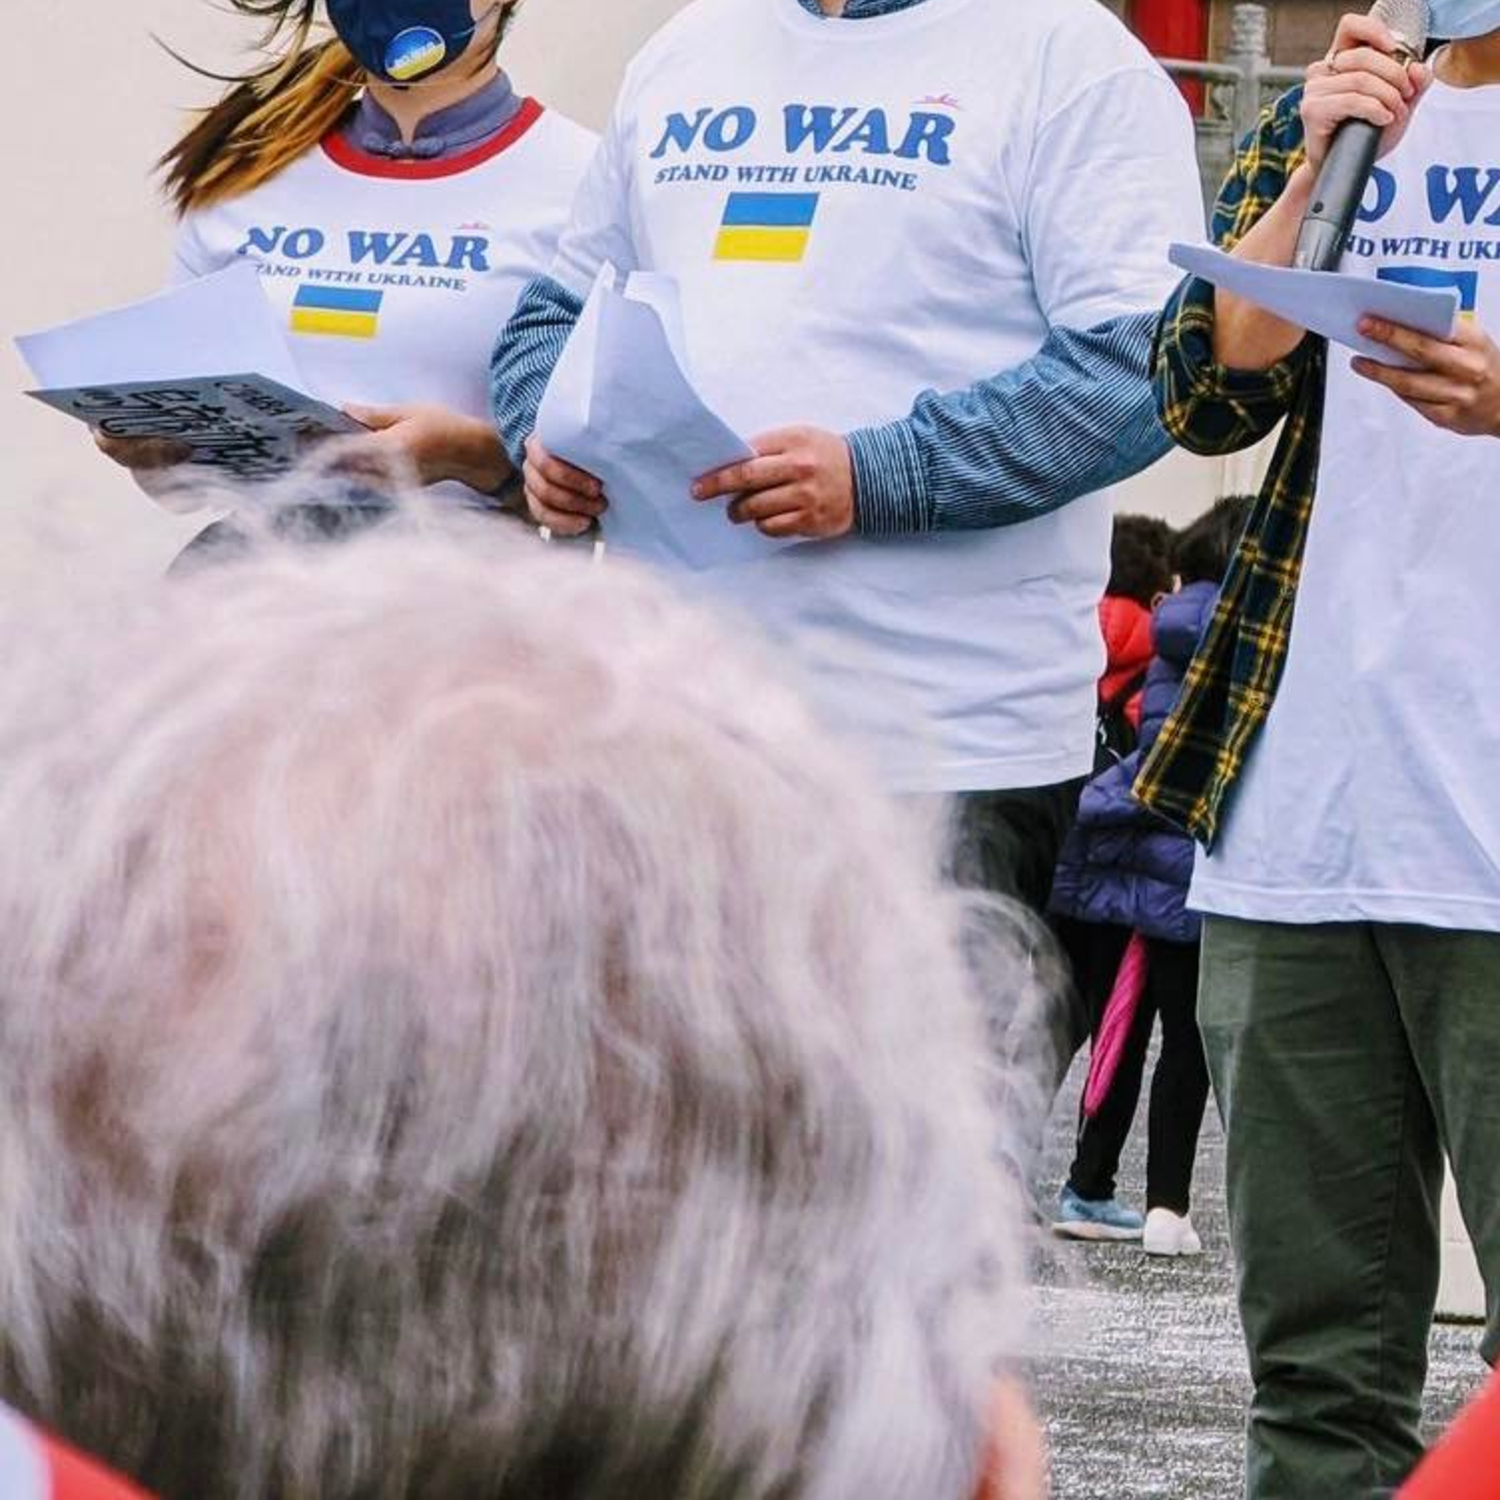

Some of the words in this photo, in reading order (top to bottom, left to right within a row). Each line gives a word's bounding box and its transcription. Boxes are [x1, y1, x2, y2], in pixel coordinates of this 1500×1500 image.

[649, 105, 757, 158] NO
[783, 103, 956, 166] WAR
[654, 165, 729, 184] STAND
[738, 166, 797, 183] WITH
[805, 165, 917, 191] UKRAINE
[236, 226, 325, 259] NO
[347, 230, 491, 272] WAR
[1382, 237, 1450, 259] WITH
[308, 268, 362, 283] WITH
[368, 273, 467, 292] UKRAINE
